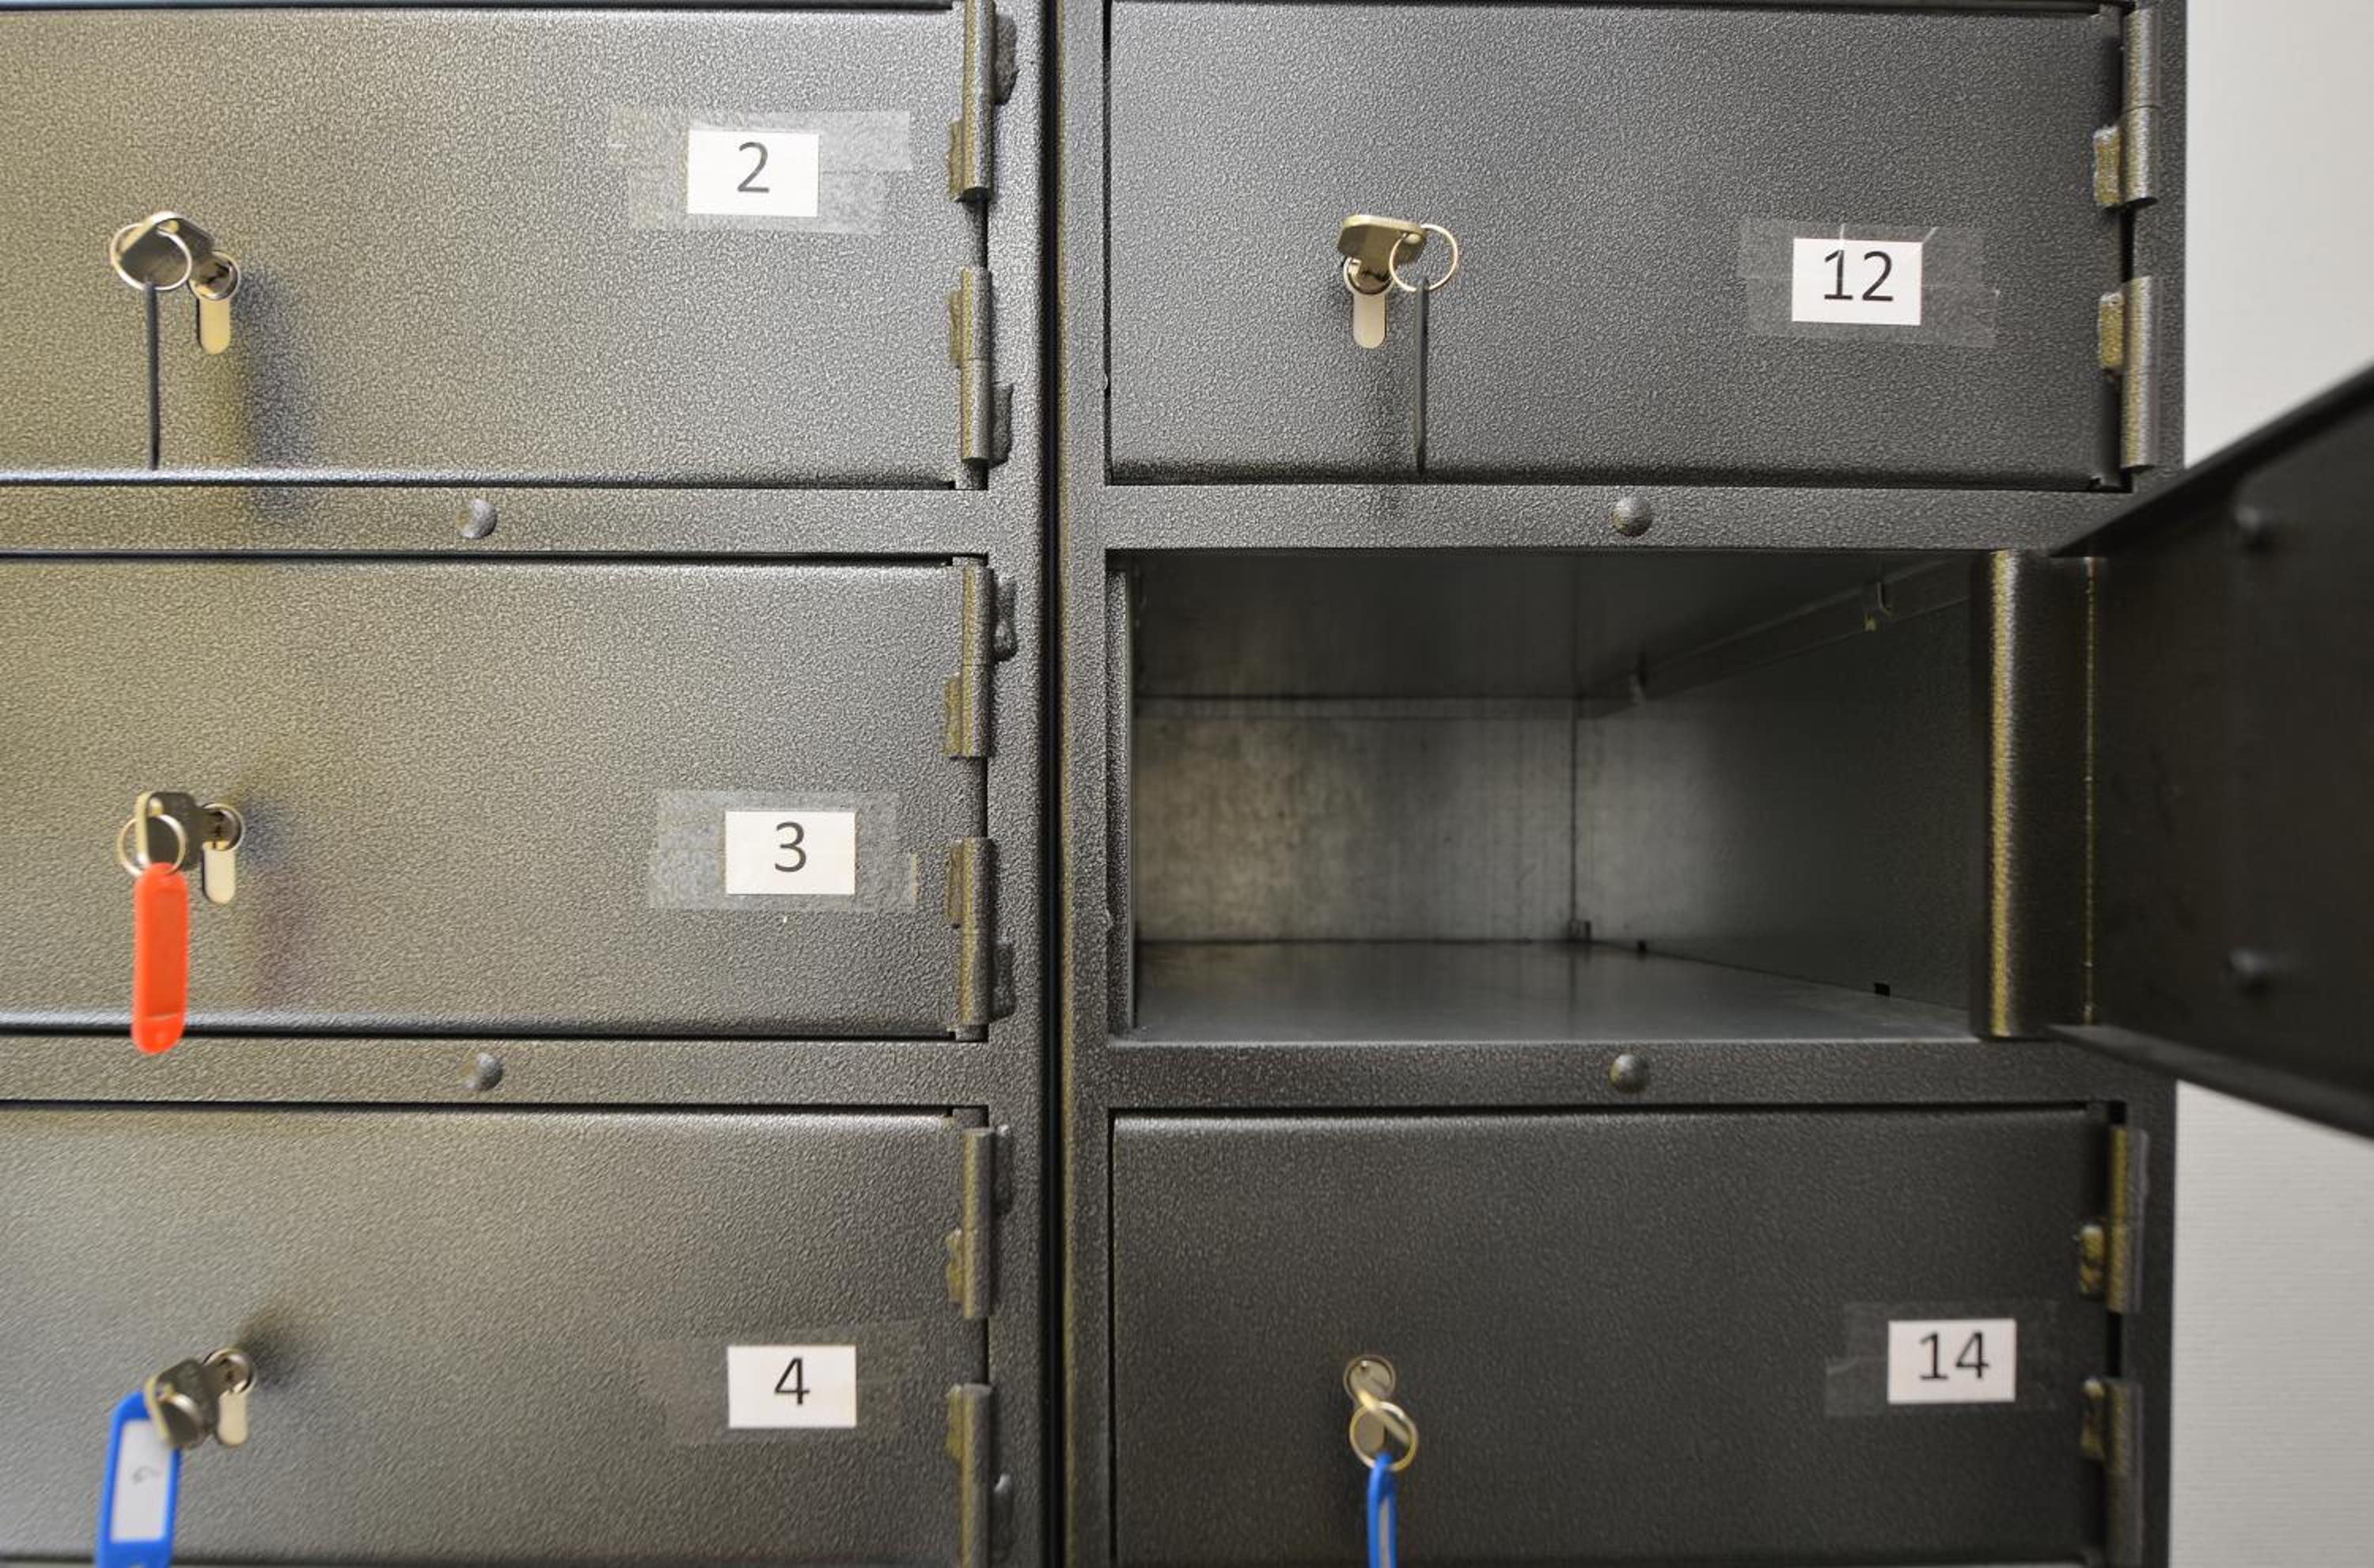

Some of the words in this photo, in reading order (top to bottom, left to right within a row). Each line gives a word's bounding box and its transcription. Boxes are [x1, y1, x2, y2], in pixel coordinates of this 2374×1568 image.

[737, 142, 769, 192] 2
[1824, 250, 1894, 302] 12
[775, 822, 807, 873] 3
[1920, 1331, 1990, 1381] 14
[775, 1357, 810, 1406] 4
